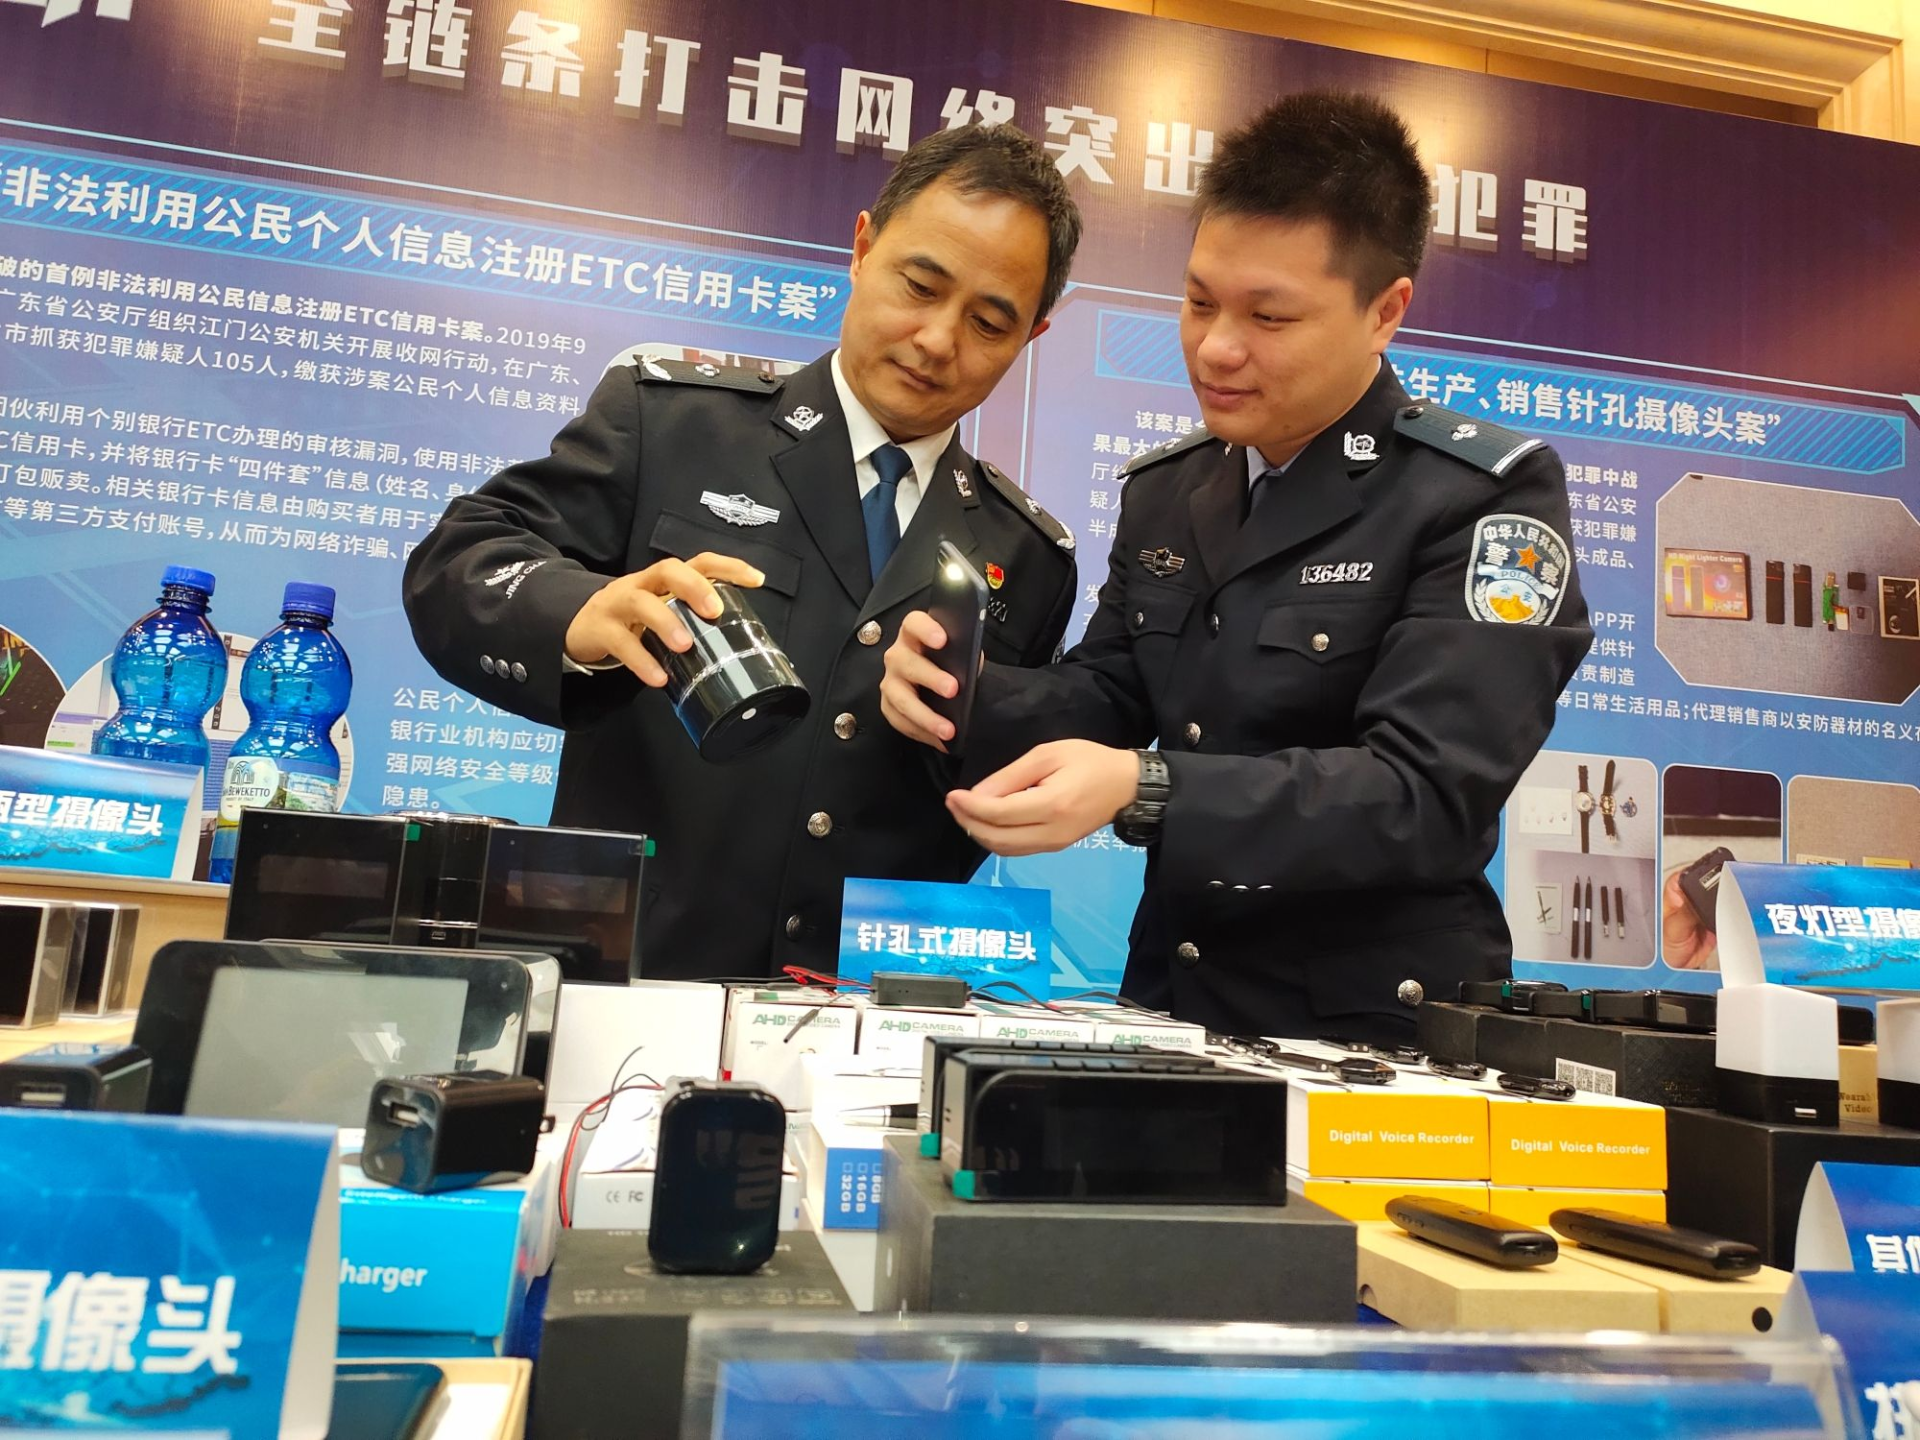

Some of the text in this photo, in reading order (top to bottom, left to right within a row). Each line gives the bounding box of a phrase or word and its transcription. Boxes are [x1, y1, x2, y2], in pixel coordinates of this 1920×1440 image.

[0, 162, 837, 322] 非法利用公民个人信息注册ETC信用卡案”
[0, 430, 478, 502] C信用卡，并将银行卡“四件套”信息（姓名、身
[1566, 463, 1638, 490] 犯罪中战
[1568, 492, 1637, 515] 东省公安
[1483, 524, 1566, 570] 中华人民共和国
[1575, 546, 1634, 569] 头成品、
[1299, 562, 1374, 584] 136482
[1501, 569, 1541, 589] POLICE
[505, 574, 526, 599] JING
[1589, 611, 1636, 631] PP开
[390, 719, 564, 753] 银行业机构应切
[386, 752, 558, 786] 强网络安全等级
[382, 785, 440, 809] 隐患。
[857, 922, 1037, 961] 针孔式摄像头
[752, 1014, 786, 1026] AHD
[879, 1020, 964, 1032] AHD CAMERA
[997, 1027, 1079, 1038] AHD CAMERA
[1112, 1034, 1142, 1046] AHD
[1143, 1035, 1192, 1044] CAMERA
[1329, 1130, 1475, 1145] Digital Voice Recorder
[1511, 1138, 1651, 1155] Digital Voice Recorder
[841, 1174, 853, 1213] 32GB
[856, 1174, 867, 1213] 16GB
